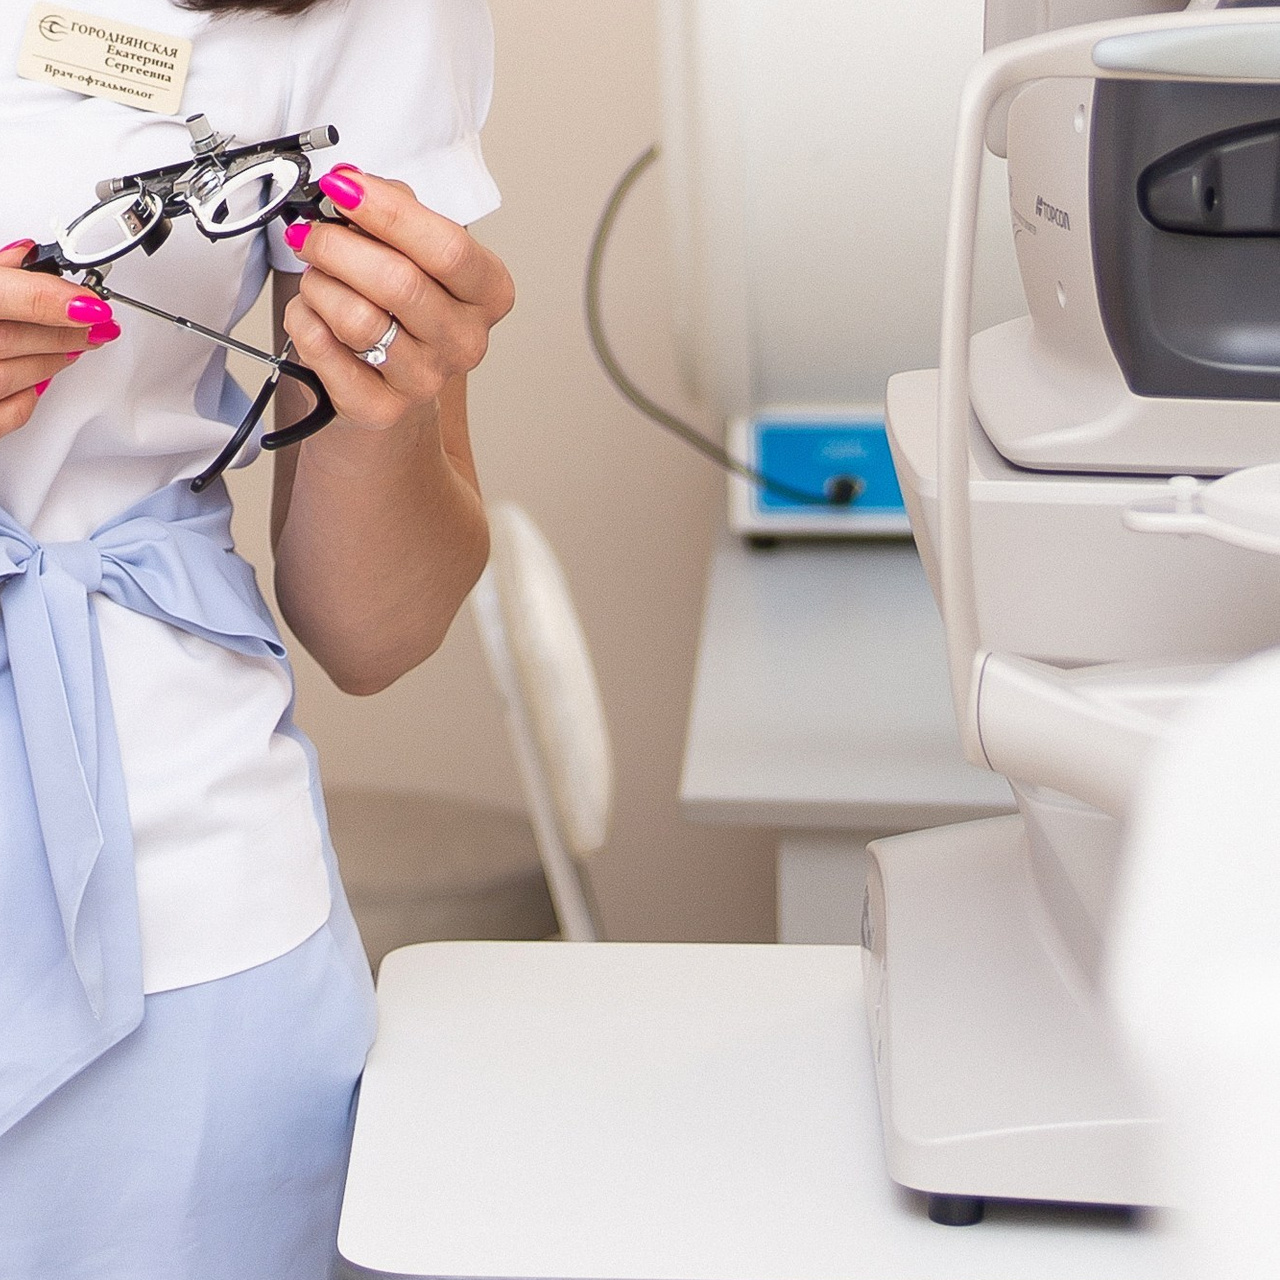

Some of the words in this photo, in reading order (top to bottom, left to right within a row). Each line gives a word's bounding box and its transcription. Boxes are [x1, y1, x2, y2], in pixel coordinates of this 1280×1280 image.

[71, 22, 178, 58] ГОРОДНЯНСКАЯ
[105, 57, 172, 83] Сергеевна
[106, 45, 174, 71] Екатерина
[44, 63, 154, 100] Врач-офтальмолог
